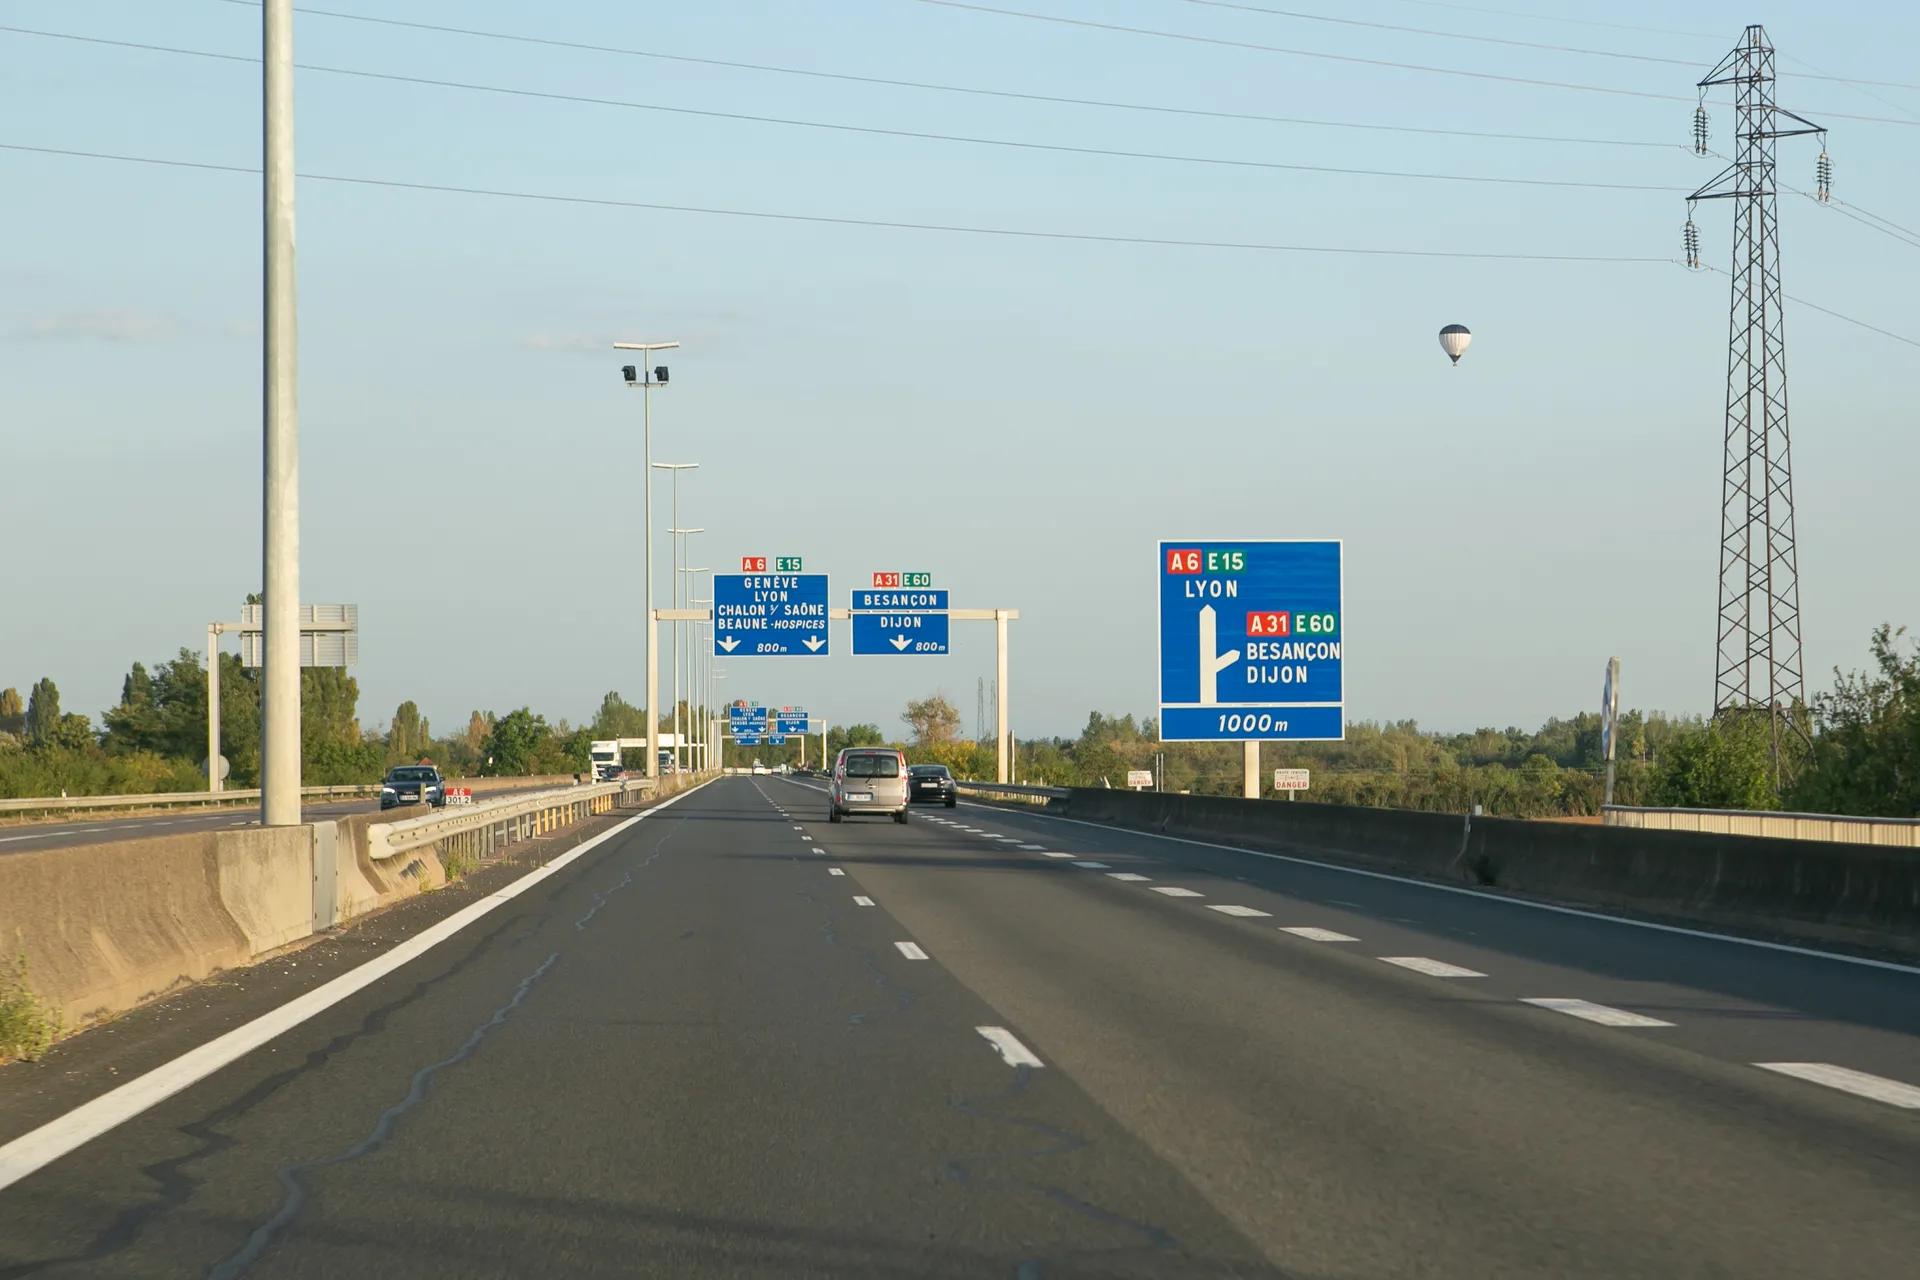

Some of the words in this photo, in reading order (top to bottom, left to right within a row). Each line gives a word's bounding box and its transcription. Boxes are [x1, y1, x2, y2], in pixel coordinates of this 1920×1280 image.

[1185, 579, 1237, 598] LYON
[754, 590, 788, 602] LYON
[864, 594, 937, 608] BESANÇON
[718, 604, 766, 616] CHALON
[784, 602, 825, 616] SAÔNE
[718, 618, 768, 630] BEAUNE
[880, 616, 921, 628] DIJON
[1246, 641, 1340, 662] BESANÇON
[1247, 665, 1308, 684] DIJON
[1276, 781, 1308, 789] DANGER
